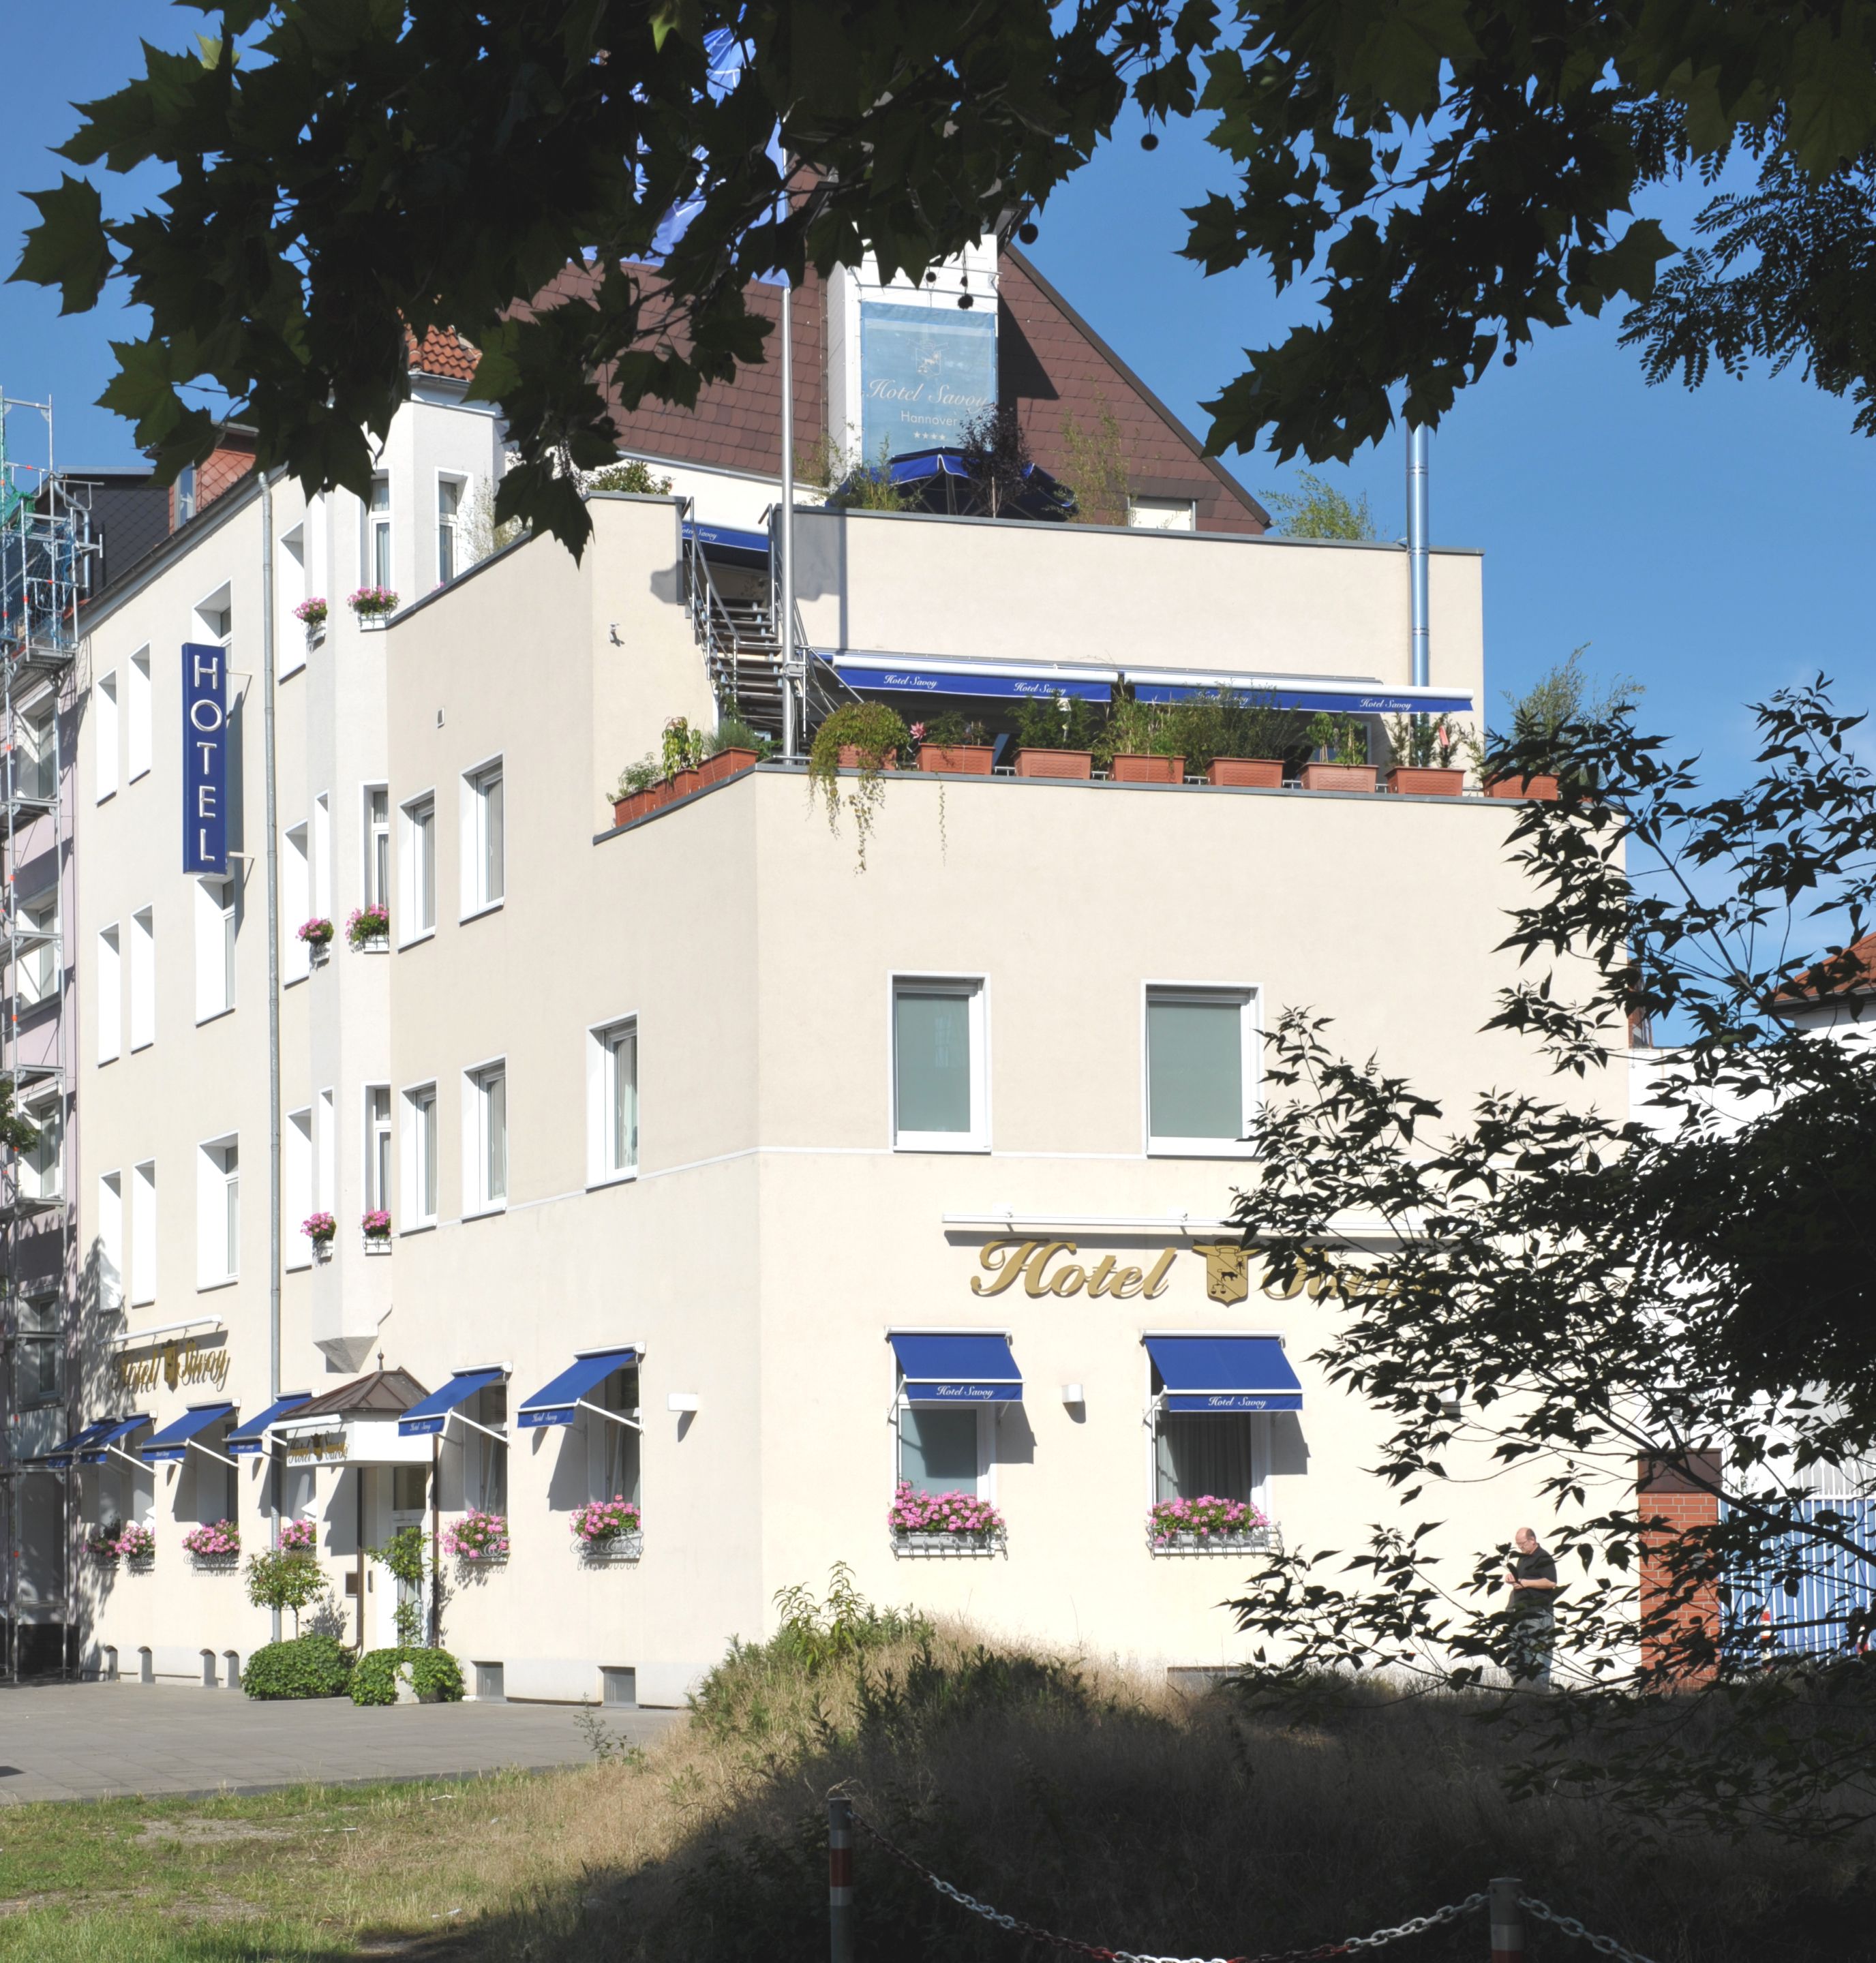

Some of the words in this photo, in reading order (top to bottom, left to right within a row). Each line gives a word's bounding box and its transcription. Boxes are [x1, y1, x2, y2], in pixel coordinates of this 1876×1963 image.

[866, 379, 924, 400] Hotel
[927, 383, 988, 413] Savoy
[901, 410, 958, 427] Hannover
[883, 675, 910, 685] Hotel
[910, 675, 937, 689] Savoy
[1013, 682, 1040, 693] Hotel
[1359, 698, 1385, 708] Hotel
[1385, 699, 1412, 711] Savoy
[191, 655, 223, 862] HOTEL
[970, 1237, 1177, 1297] Hotel
[177, 1339, 228, 1386] Savoy
[936, 1385, 965, 1396] Hotel
[964, 1386, 994, 1399] Savoy
[1208, 1396, 1235, 1406] Hotel
[1238, 1396, 1267, 1409] Savoy
